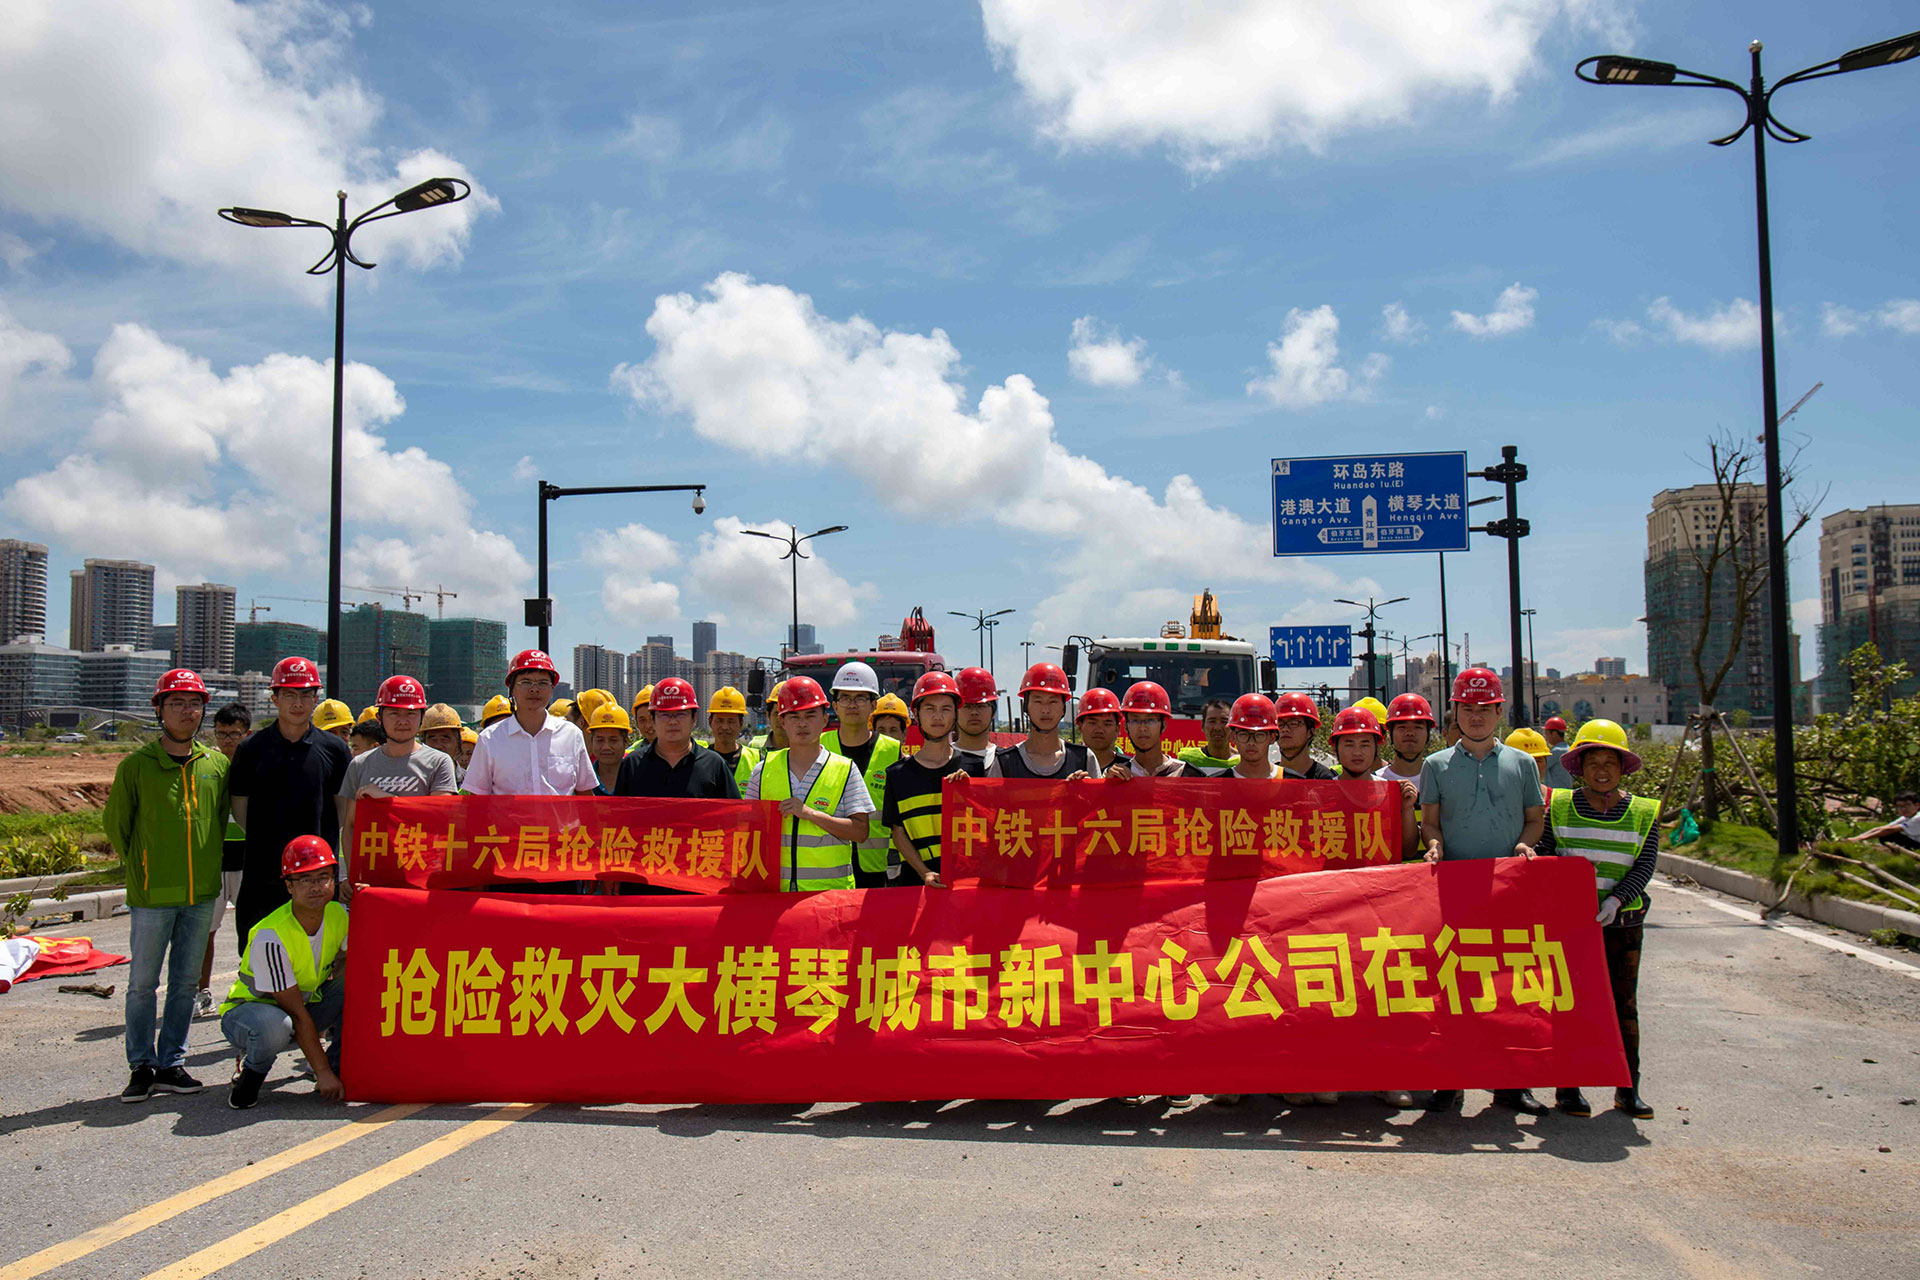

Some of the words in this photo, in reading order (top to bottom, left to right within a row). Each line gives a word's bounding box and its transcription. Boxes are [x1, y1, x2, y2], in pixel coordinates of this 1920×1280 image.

[1332, 461, 1405, 480] 环岛东路
[1333, 482, 1375, 490] Huandao
[1280, 497, 1351, 516] 港澳大道
[1388, 493, 1461, 512] 横琴大道
[1329, 516, 1351, 524] Ave.
[1390, 513, 1433, 523] Hengqin
[1440, 512, 1461, 520] Ave.
[951, 807, 1393, 861] 中铁十六局抢险救援队
[359, 822, 769, 880] 中铁十六局抢险救援队
[380, 924, 1575, 1038] 抢险救灾大横琴城市新中心公司在行动
